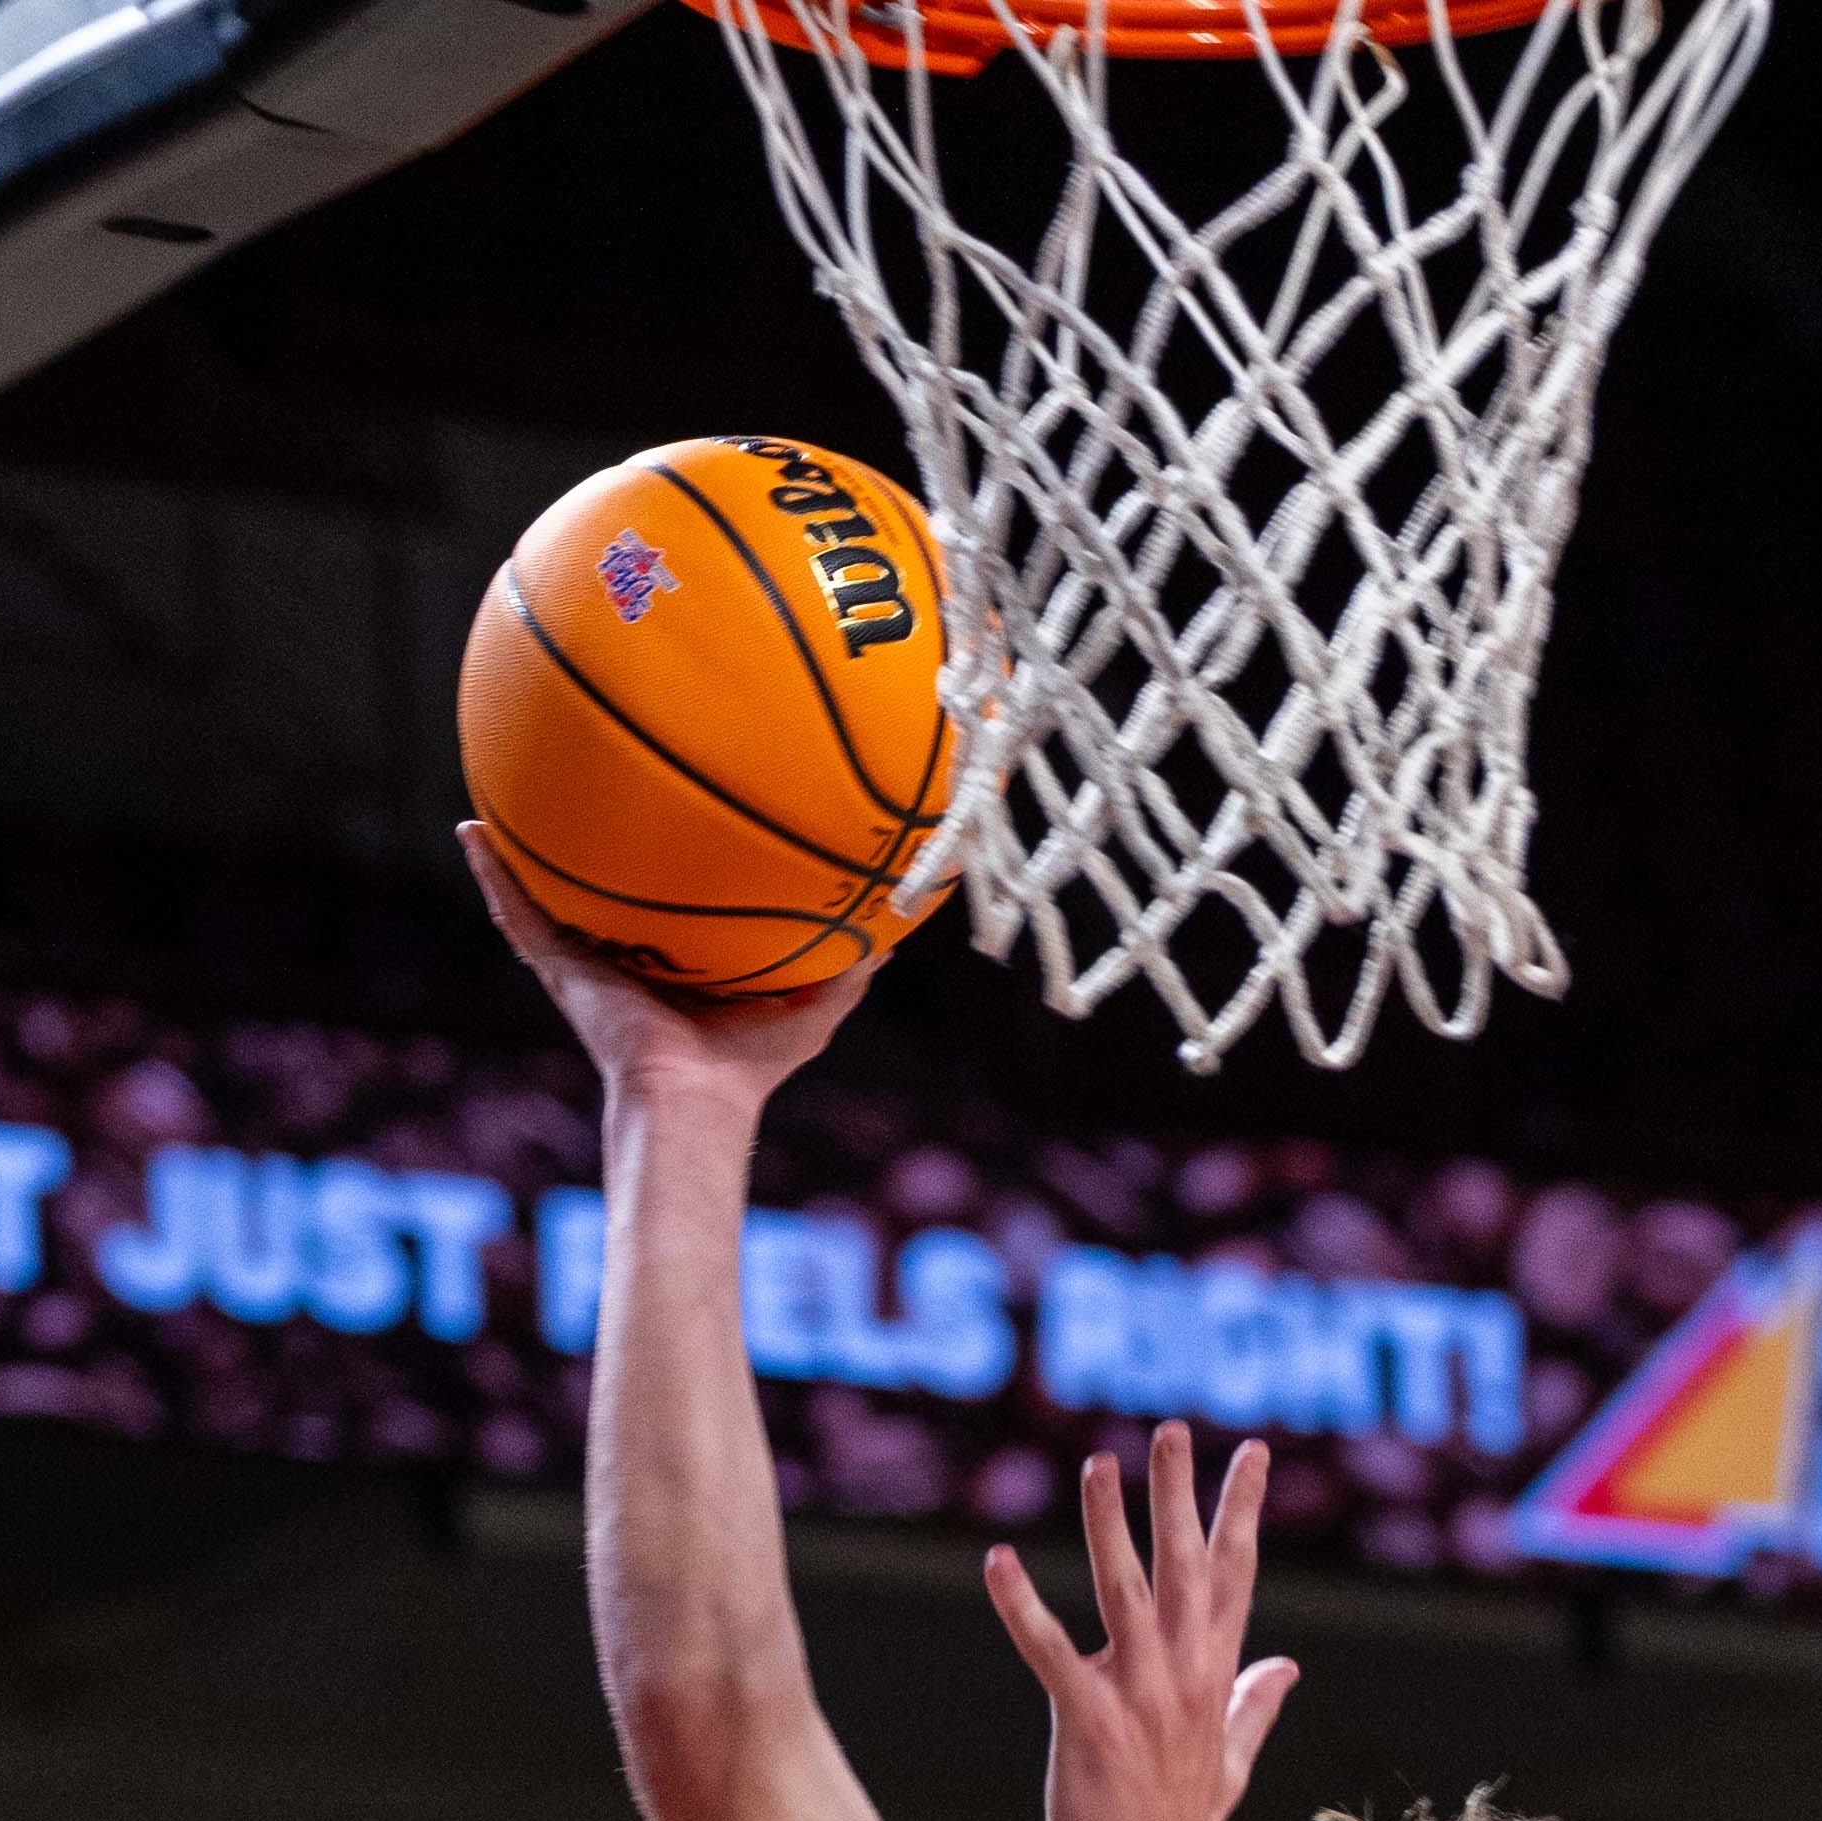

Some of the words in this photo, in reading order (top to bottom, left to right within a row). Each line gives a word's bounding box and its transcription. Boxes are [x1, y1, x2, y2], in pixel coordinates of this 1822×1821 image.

[714, 436, 920, 661] Wilso
[97, 1144, 511, 1341] JUST
[536, 1187, 1017, 1398] FELS
